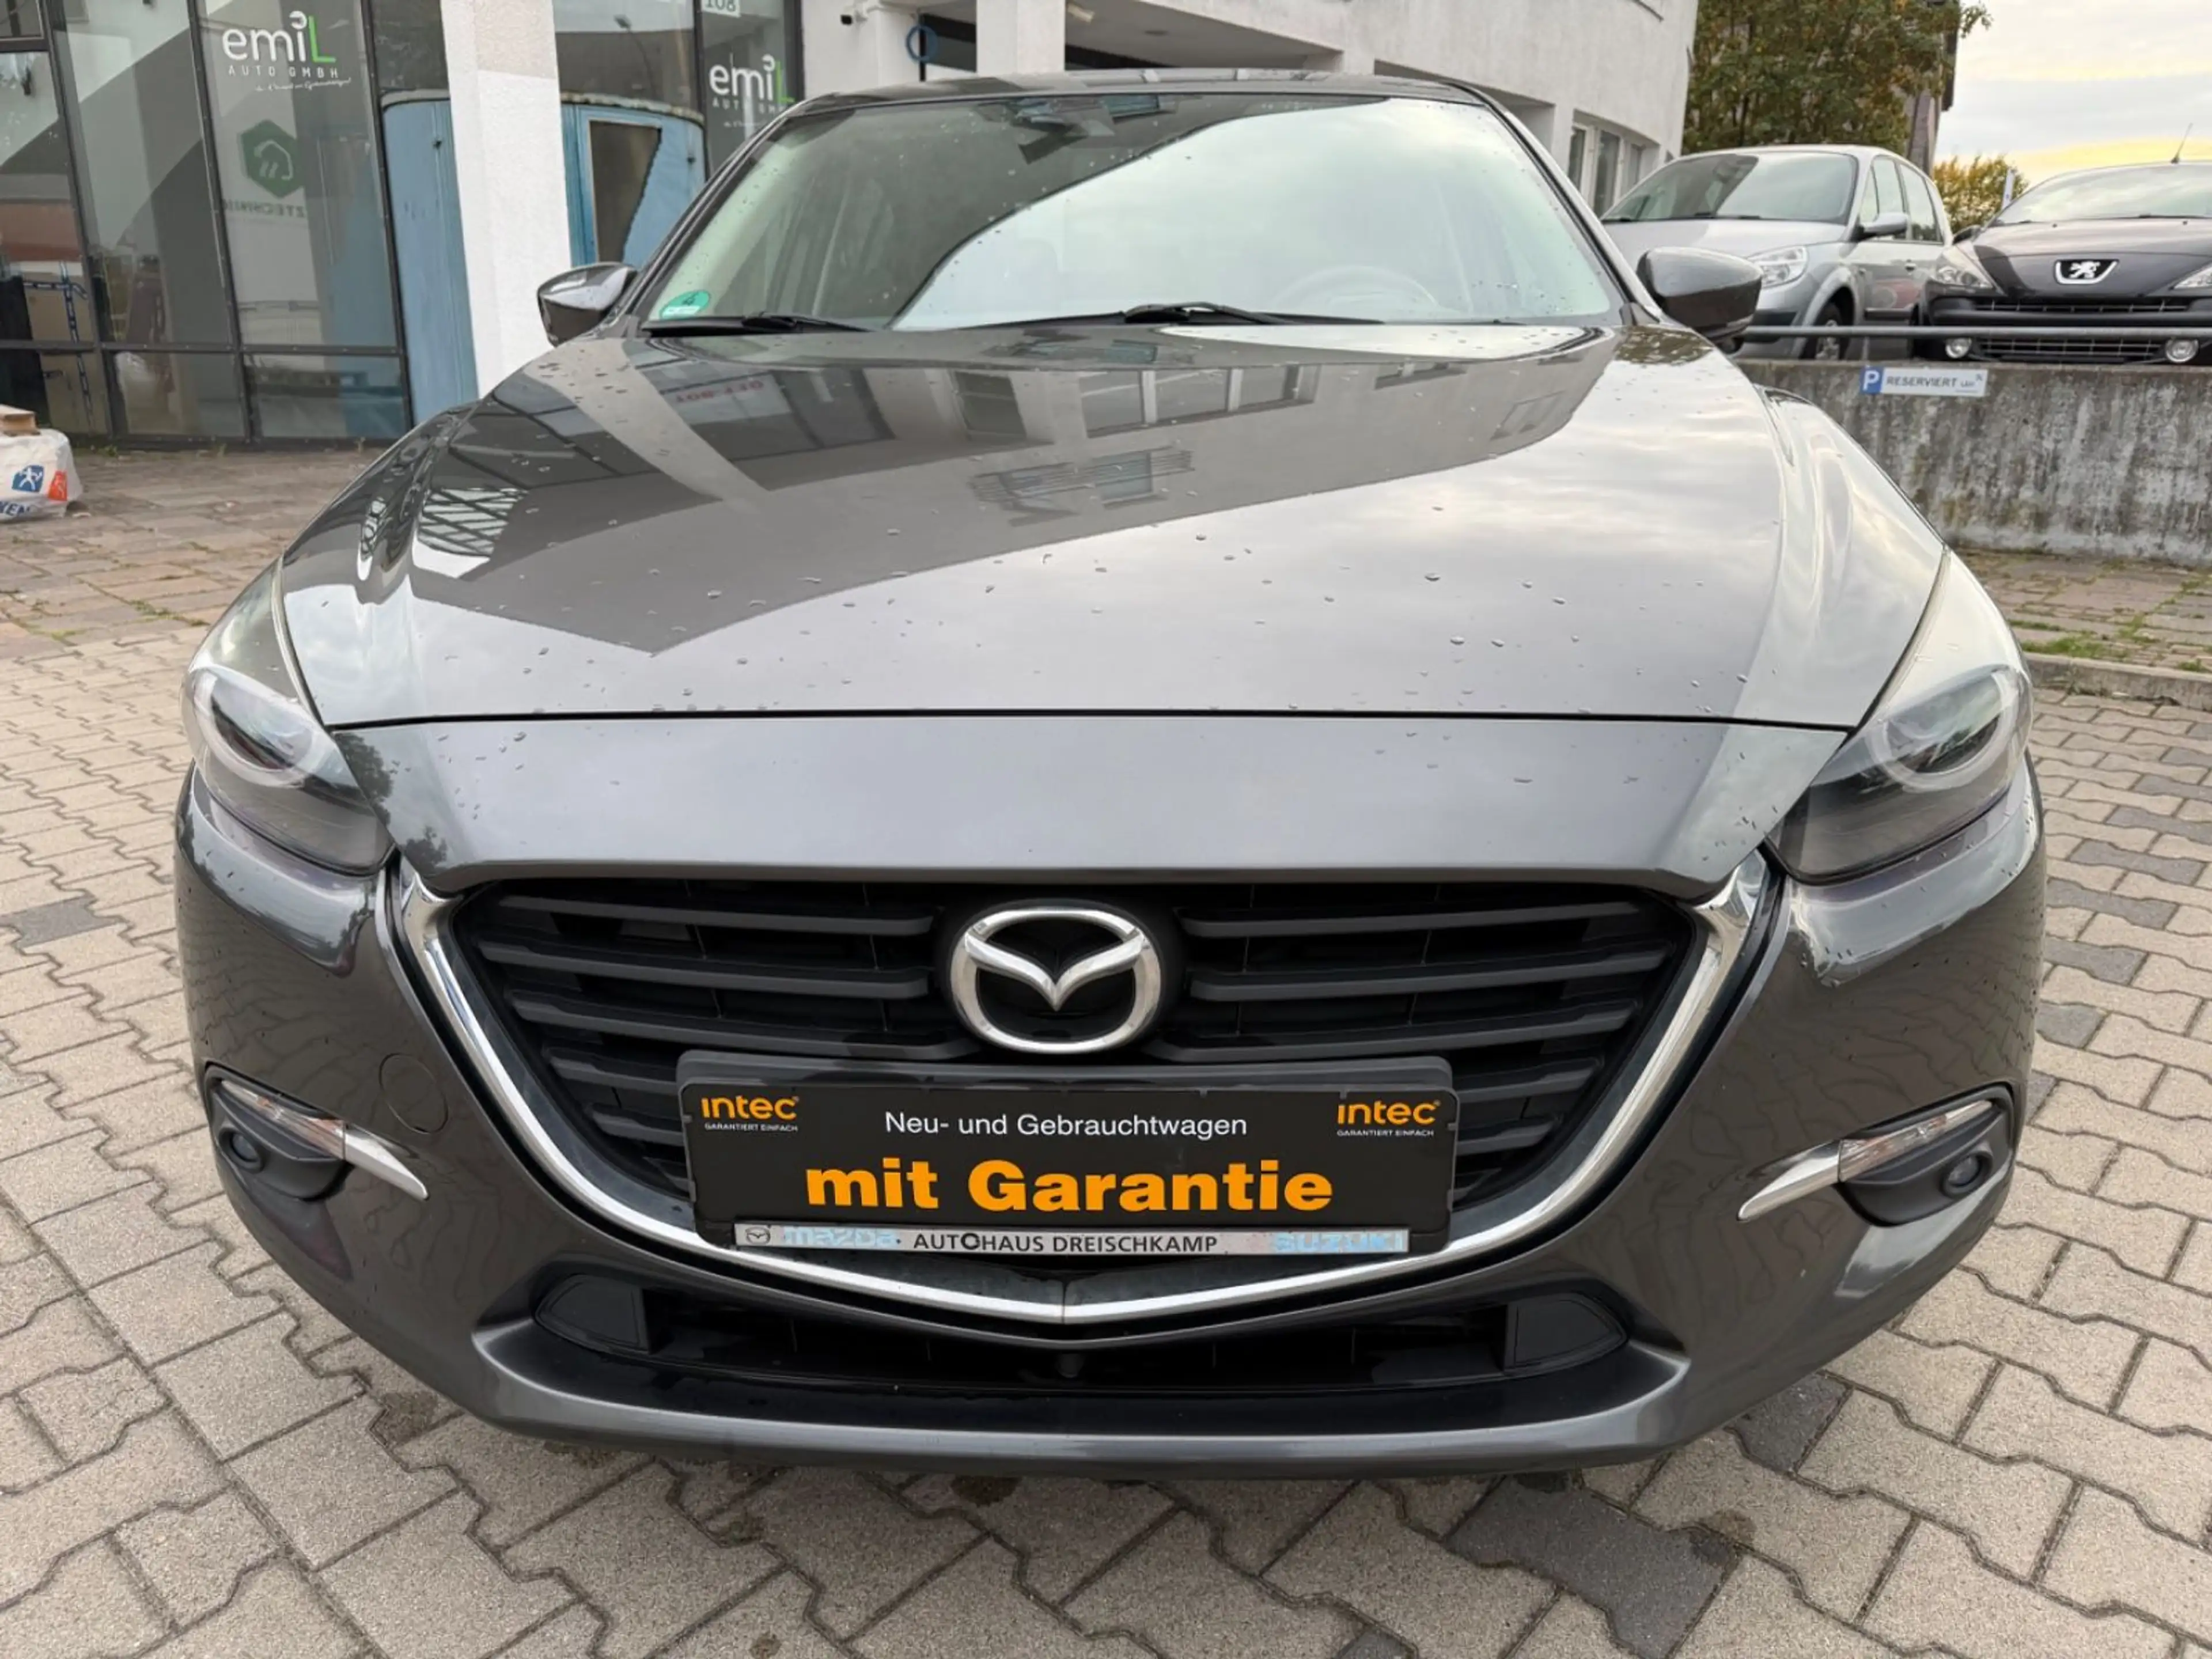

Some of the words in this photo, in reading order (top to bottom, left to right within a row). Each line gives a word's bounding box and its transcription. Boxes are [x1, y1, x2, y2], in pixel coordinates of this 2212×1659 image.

[229, 66, 276, 77] AUTO
[289, 67, 339, 78] GMBH
[1862, 370, 1880, 391] P
[1886, 376, 1957, 387] RESERVIERT
[701, 1095, 797, 1120] intec
[1337, 1100, 1436, 1125] intec
[760, 1124, 798, 1132] EINFACH
[885, 1112, 949, 1134] Neu-
[959, 1114, 1007, 1135] und
[1017, 1113, 1247, 1141] Gebrauchtwagen
[1336, 1129, 1392, 1137] GARANTIERT
[1395, 1129, 1434, 1137] EINFACH
[806, 1157, 939, 1209] mit
[968, 1159, 1333, 1212] Garantie
[913, 1233, 1044, 1252] AUTOHAUS
[1052, 1236, 1218, 1253] DREISCHKAMP
[1275, 1231, 1404, 1252] SUZUKI
